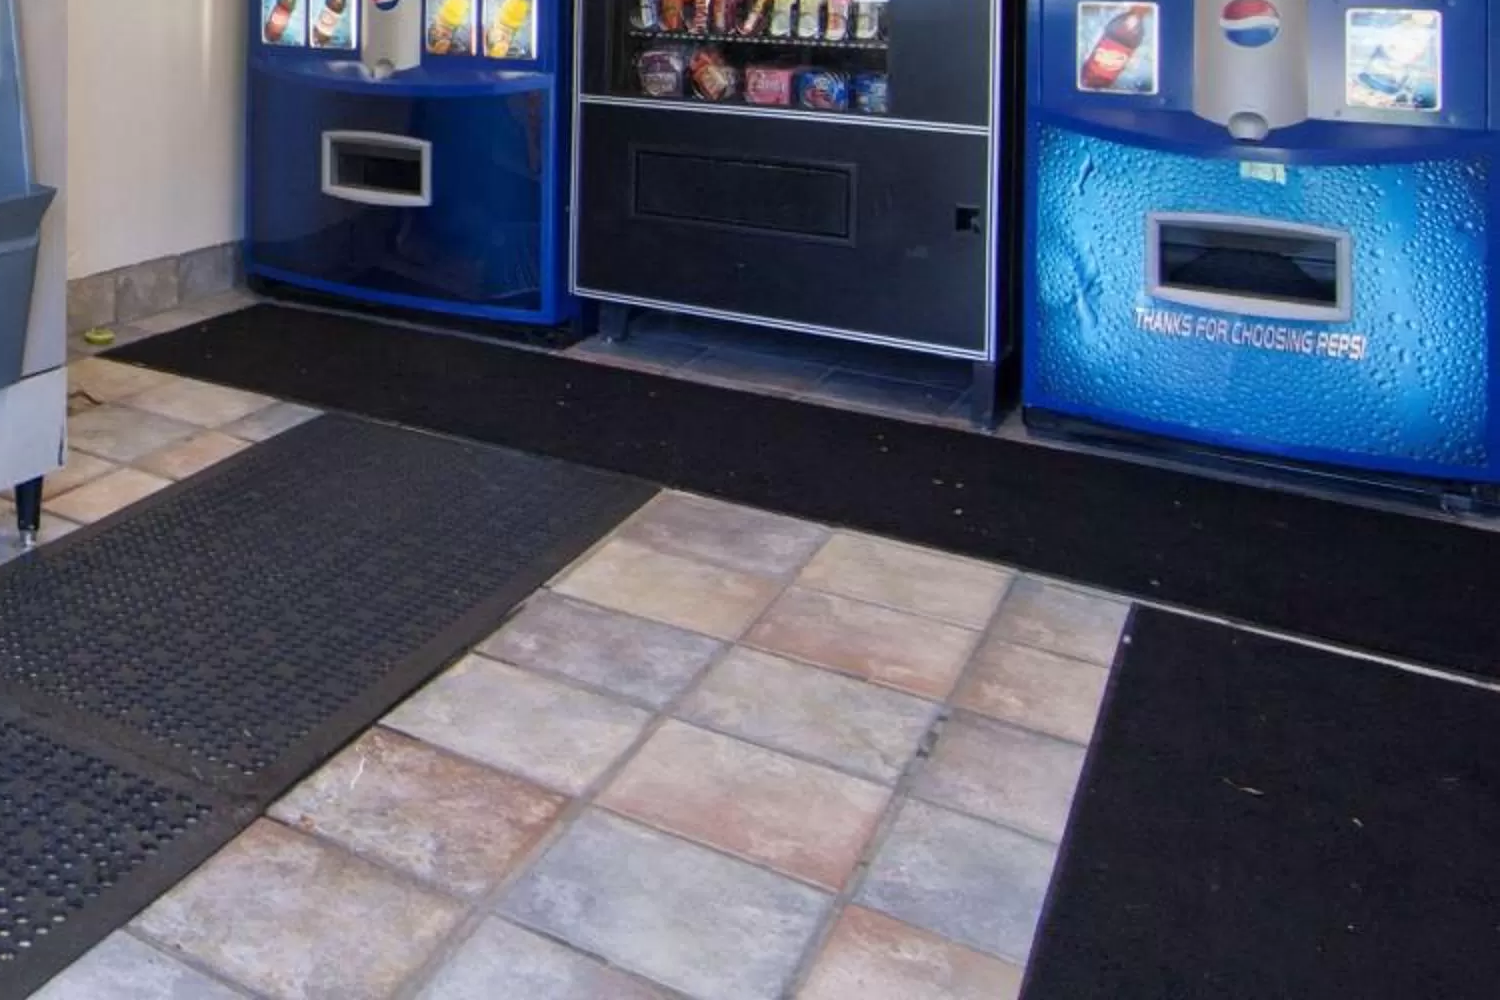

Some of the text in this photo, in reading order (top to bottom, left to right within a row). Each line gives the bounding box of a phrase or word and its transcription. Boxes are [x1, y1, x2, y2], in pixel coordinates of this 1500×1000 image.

[1135, 307, 1367, 361] THANKS FOR CHOOSING PEPSI
